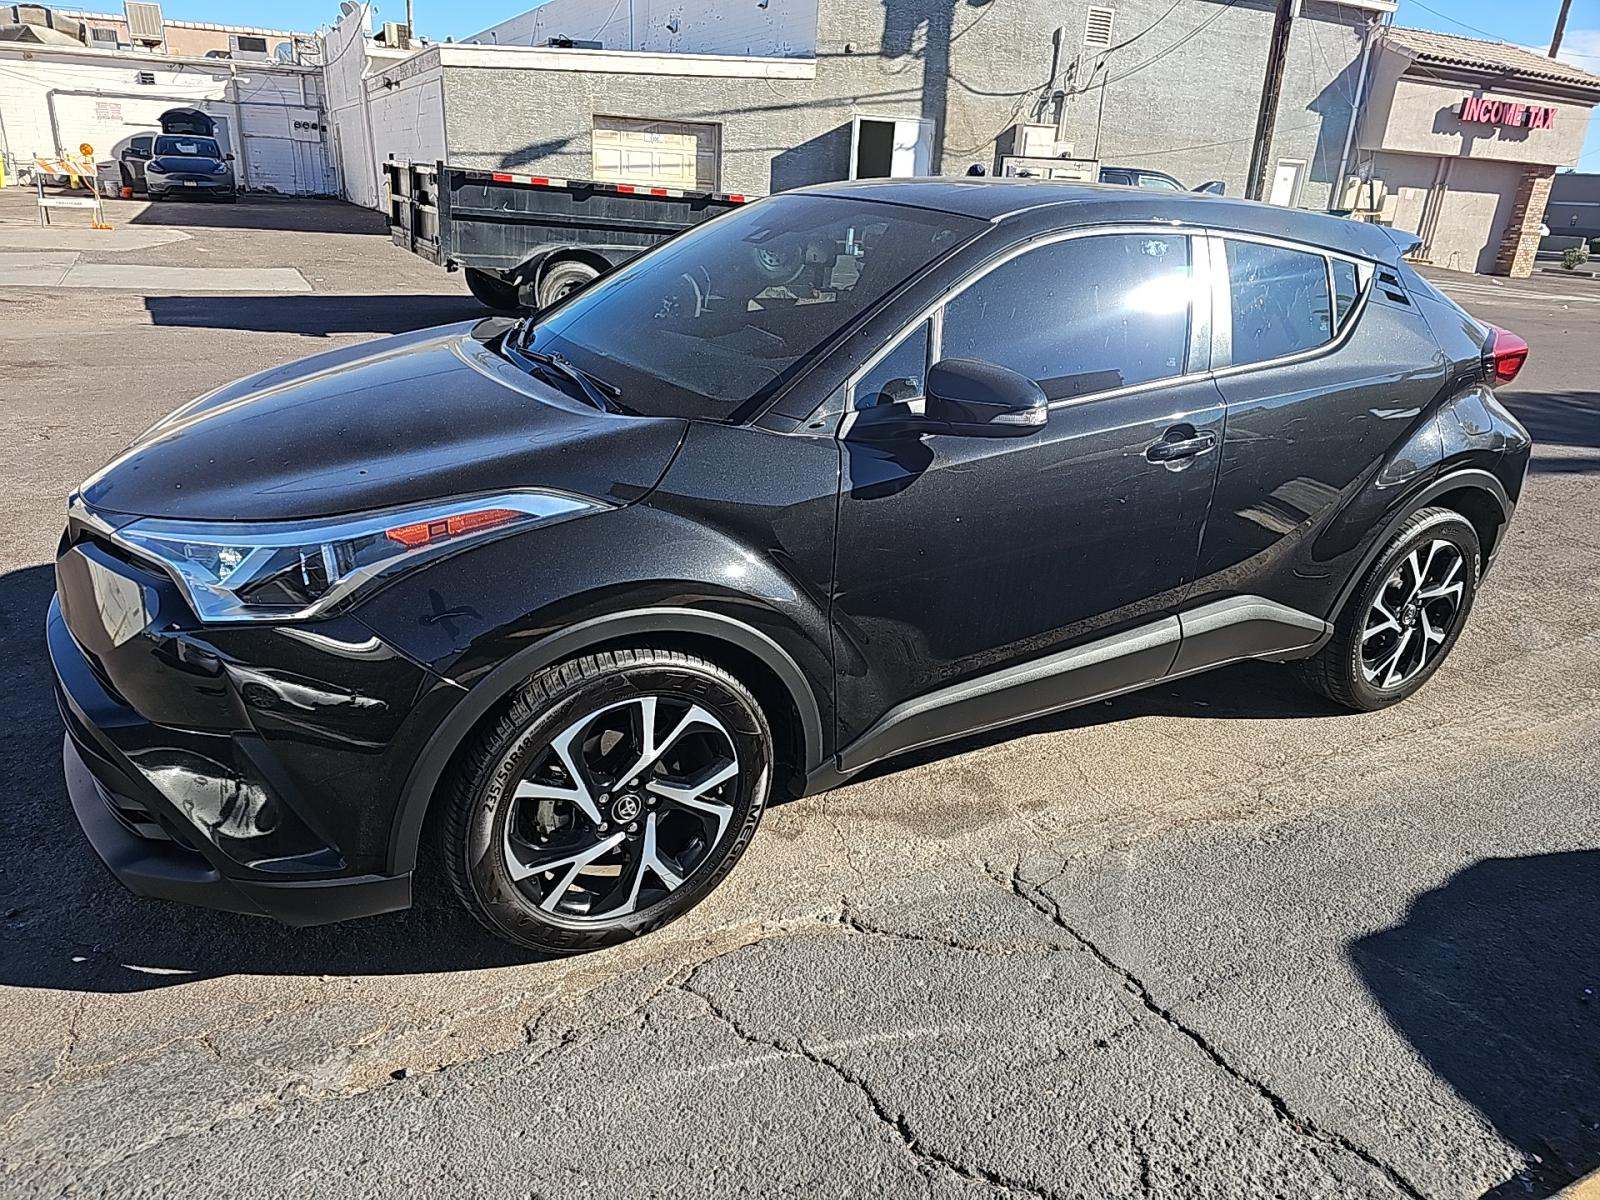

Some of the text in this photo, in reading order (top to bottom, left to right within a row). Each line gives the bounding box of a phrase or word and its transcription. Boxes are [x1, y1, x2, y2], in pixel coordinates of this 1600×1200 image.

[1461, 97, 1558, 129] INCOME TAX
[483, 737, 533, 812] 235/50R18
